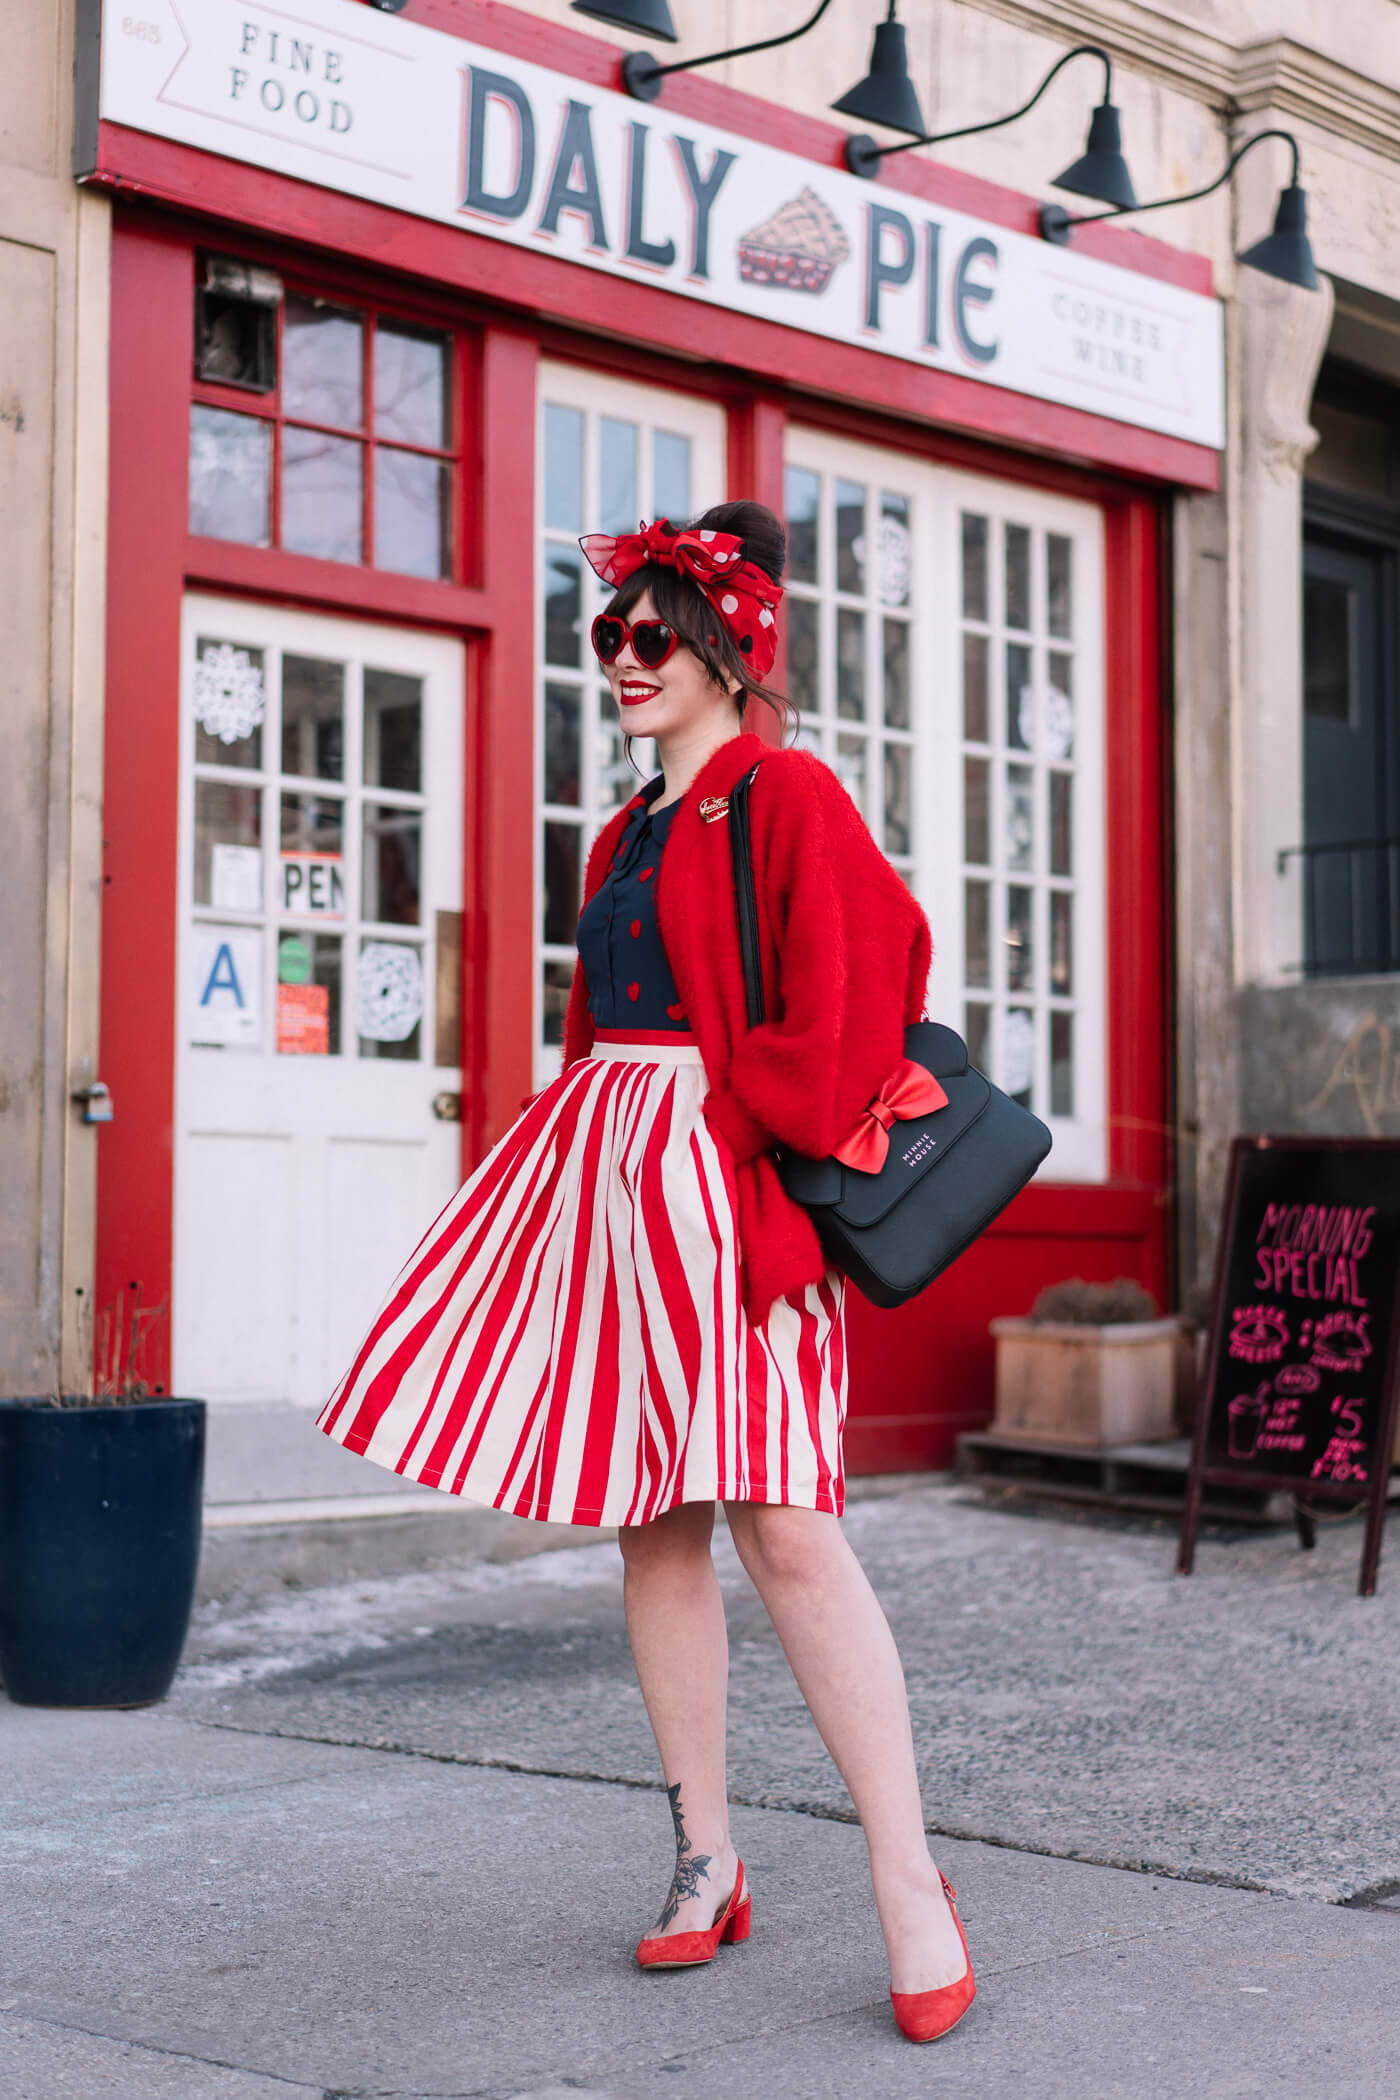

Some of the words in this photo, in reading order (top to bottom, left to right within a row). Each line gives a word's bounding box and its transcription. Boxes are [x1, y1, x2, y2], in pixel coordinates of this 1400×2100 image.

[239, 21, 346, 85] FINE
[227, 67, 354, 135] FOOD
[457, 63, 739, 285] DALY
[860, 199, 1000, 369] PIE
[1049, 291, 1166, 353] COFFEE
[1073, 335, 1148, 384] WINE
[199, 943, 246, 1009] A
[902, 1132, 930, 1162] MINNIE
[909, 1139, 937, 1168] MOUSE
[1256, 1202, 1377, 1259] MORNING
[1253, 1247, 1368, 1307] SPECIAL
